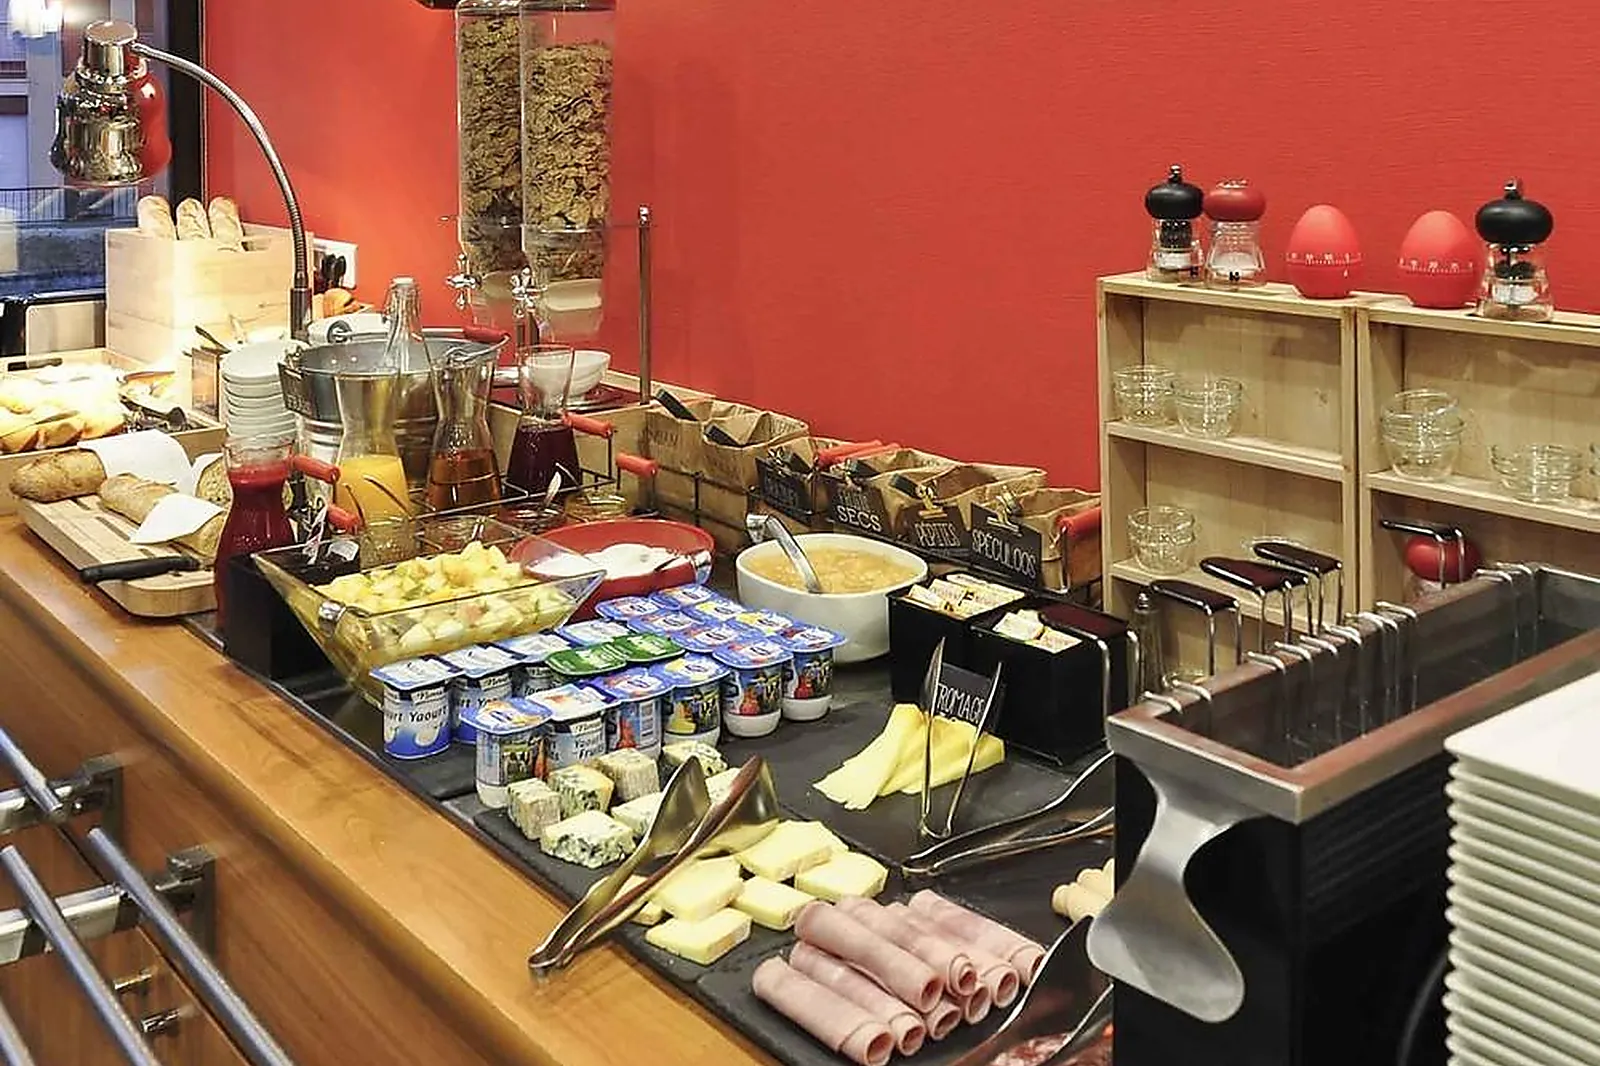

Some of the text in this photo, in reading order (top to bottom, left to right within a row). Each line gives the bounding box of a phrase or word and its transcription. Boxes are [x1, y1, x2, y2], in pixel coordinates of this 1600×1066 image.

[837, 504, 882, 533] SECS
[408, 704, 447, 723] Yaourt
[936, 682, 985, 725] ROMAG
